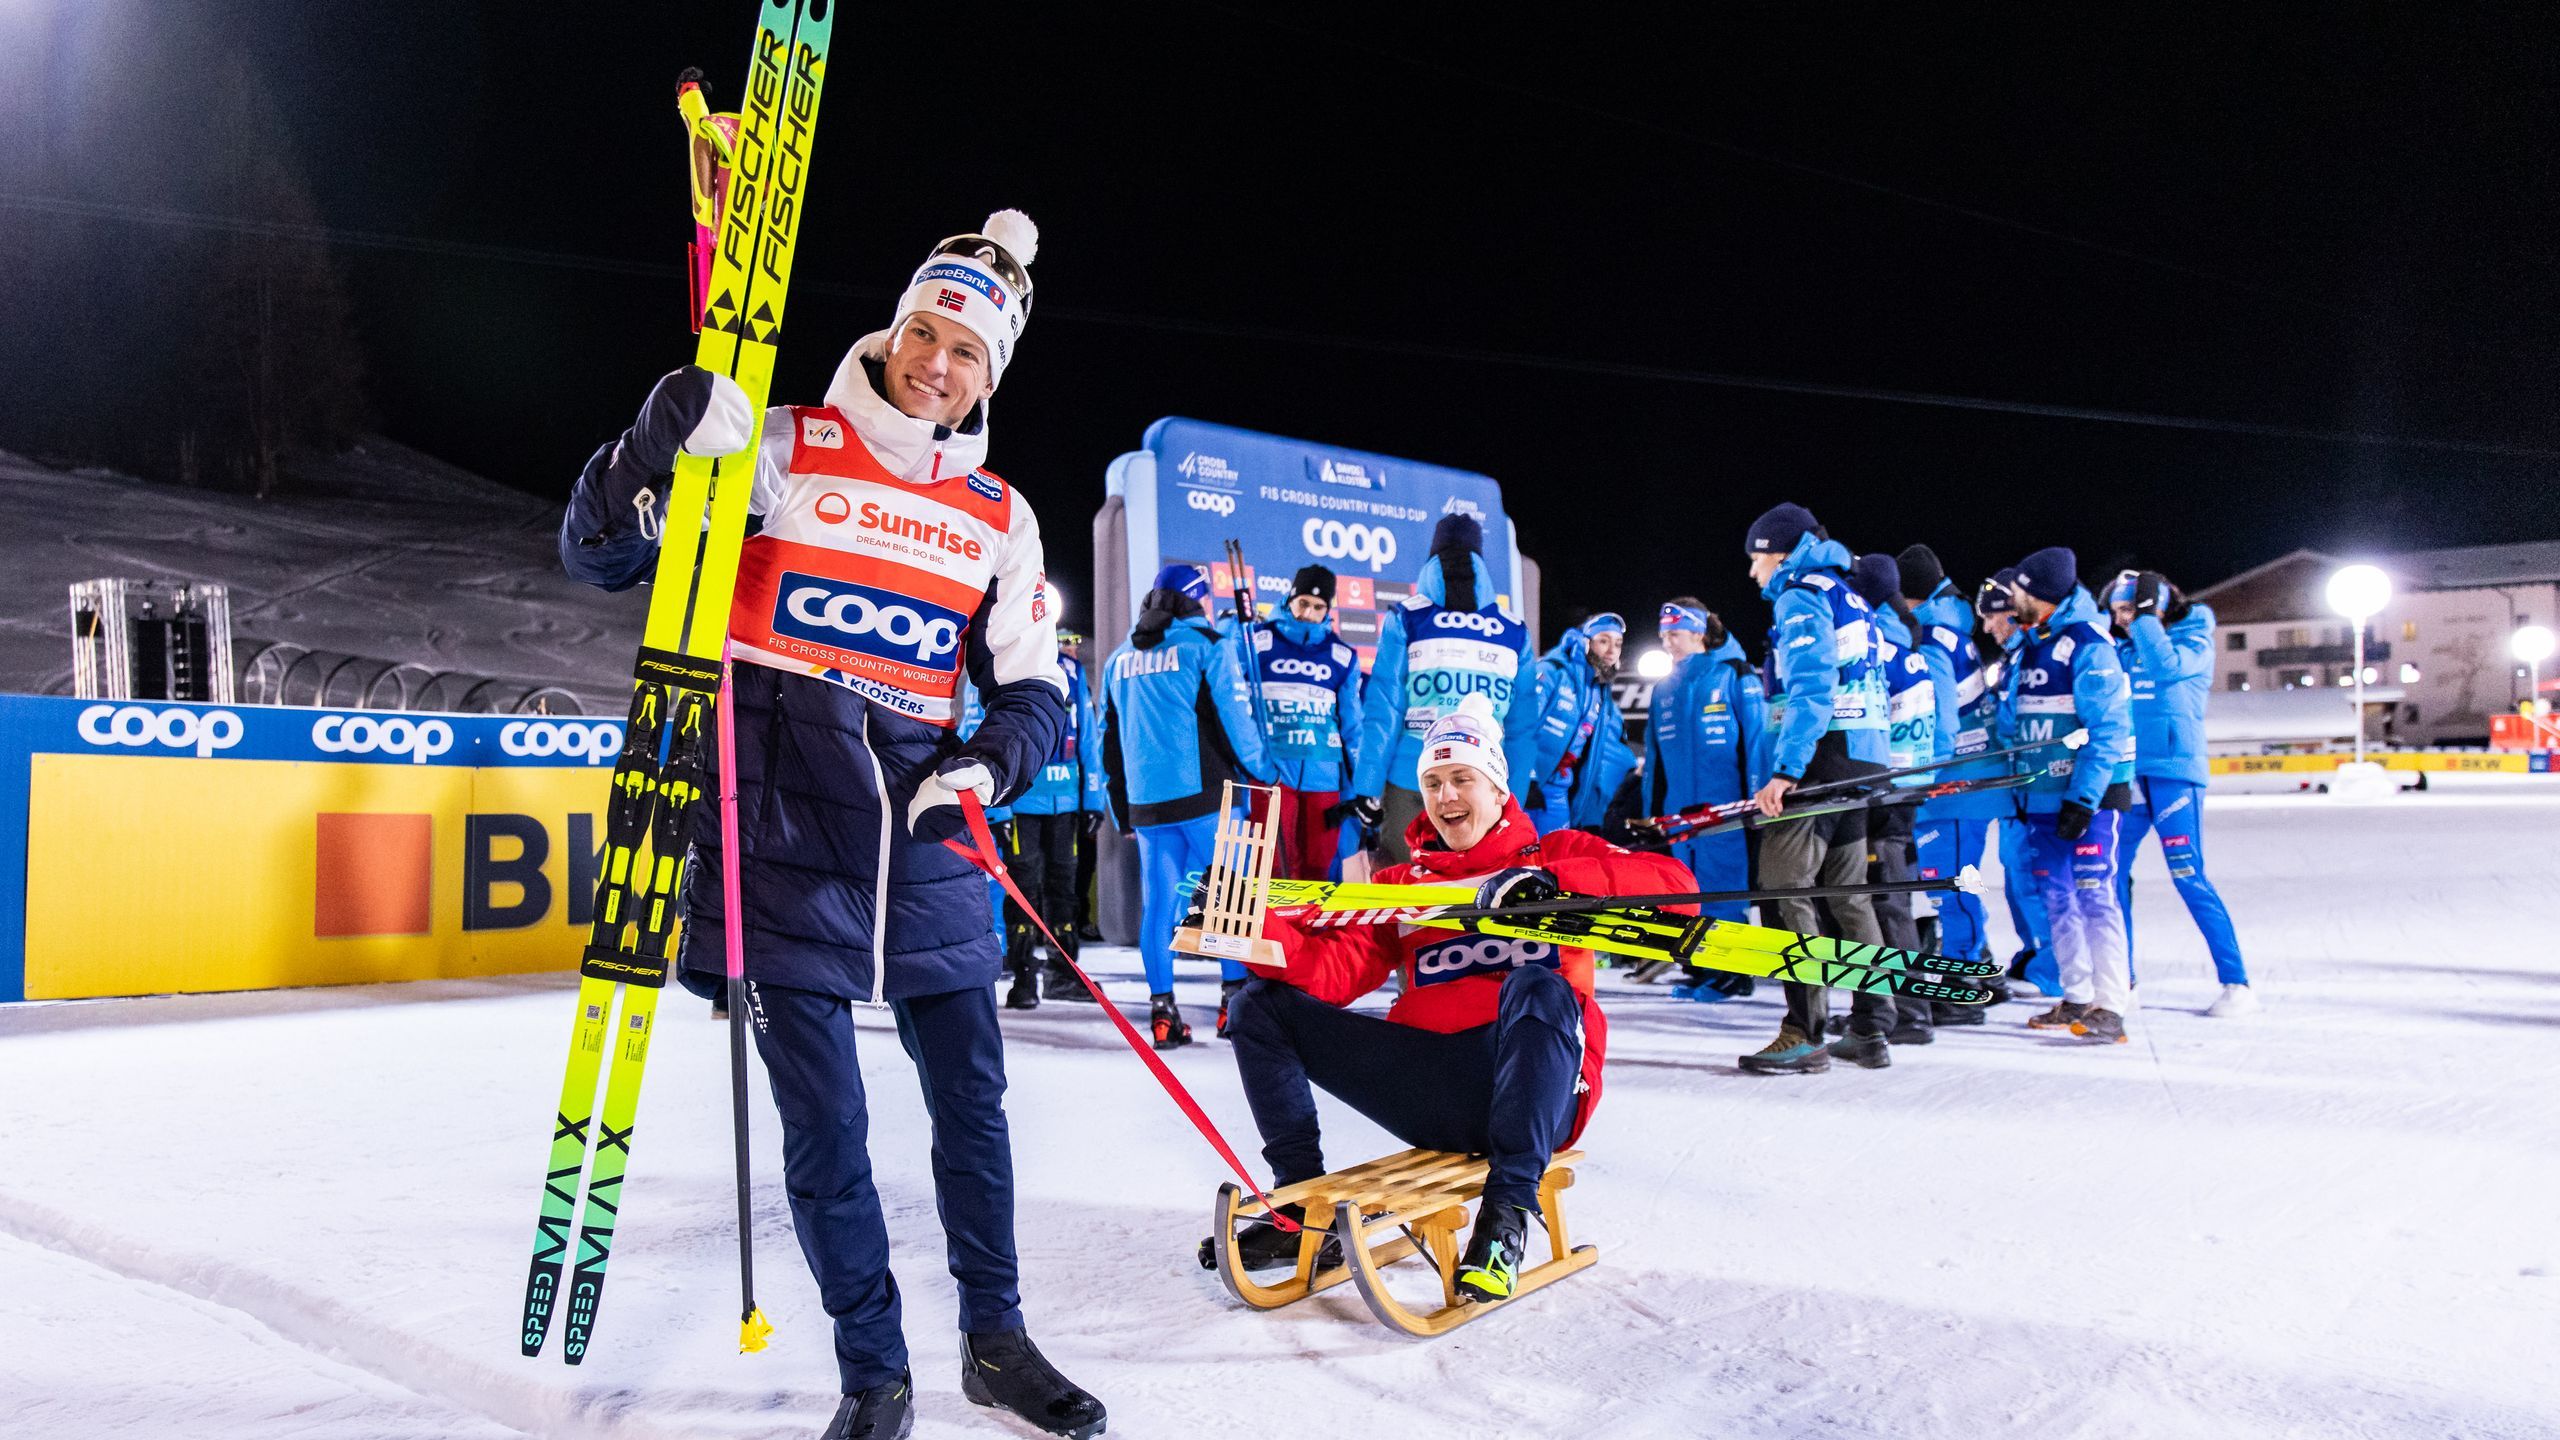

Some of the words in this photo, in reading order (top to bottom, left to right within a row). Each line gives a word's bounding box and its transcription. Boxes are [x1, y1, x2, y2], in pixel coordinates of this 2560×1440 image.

[724, 28, 784, 273] FISCHER
[762, 42, 822, 285] FISCHER
[919, 268, 989, 293] SpareBank
[968, 478, 1002, 500] coop
[1187, 490, 1236, 518] coop
[1260, 485, 1279, 501] FIS
[1281, 488, 1318, 508] CROSS
[1320, 495, 1369, 513] COUNTRY
[1371, 502, 1406, 520] WORLD
[1407, 507, 1428, 522] CUP
[858, 502, 982, 561] Sunrise
[1302, 517, 1397, 573] coop
[856, 535, 891, 549] DREAM
[892, 543, 911, 554] BIG.
[913, 548, 928, 559] DO
[929, 554, 946, 566] BIG.
[1257, 575, 1292, 594] coop
[786, 587, 958, 661] coop
[1433, 611, 1505, 637] coop
[641, 660, 719, 682] FISCHER
[768, 637, 787, 650] FIS
[790, 643, 836, 661] CROSS
[840, 654, 900, 675] COUNTRY
[903, 669, 937, 684] WORLD
[938, 675, 953, 685] CUP
[1116, 645, 1180, 682] ITALIA
[1270, 658, 1332, 682] coop
[850, 678, 925, 714] KLOSTERS
[1439, 697, 1462, 706] 202
[77, 705, 245, 758] coop
[311, 714, 454, 764] coop
[500, 721, 624, 766] coop
[1288, 729, 1317, 746] ITA
[1046, 765, 1071, 781] ITA
[462, 813, 650, 932] BK
[1514, 928, 1583, 944] FISCHER
[587, 959, 663, 978] FISCHER
[1418, 938, 1551, 975] coop
[1923, 958, 1991, 975] SPEED
[749, 980, 764, 1015] AFT
[1910, 983, 1979, 1001] SPEED
[524, 1272, 553, 1347] SPEED
[566, 1282, 595, 1357] SPEED
